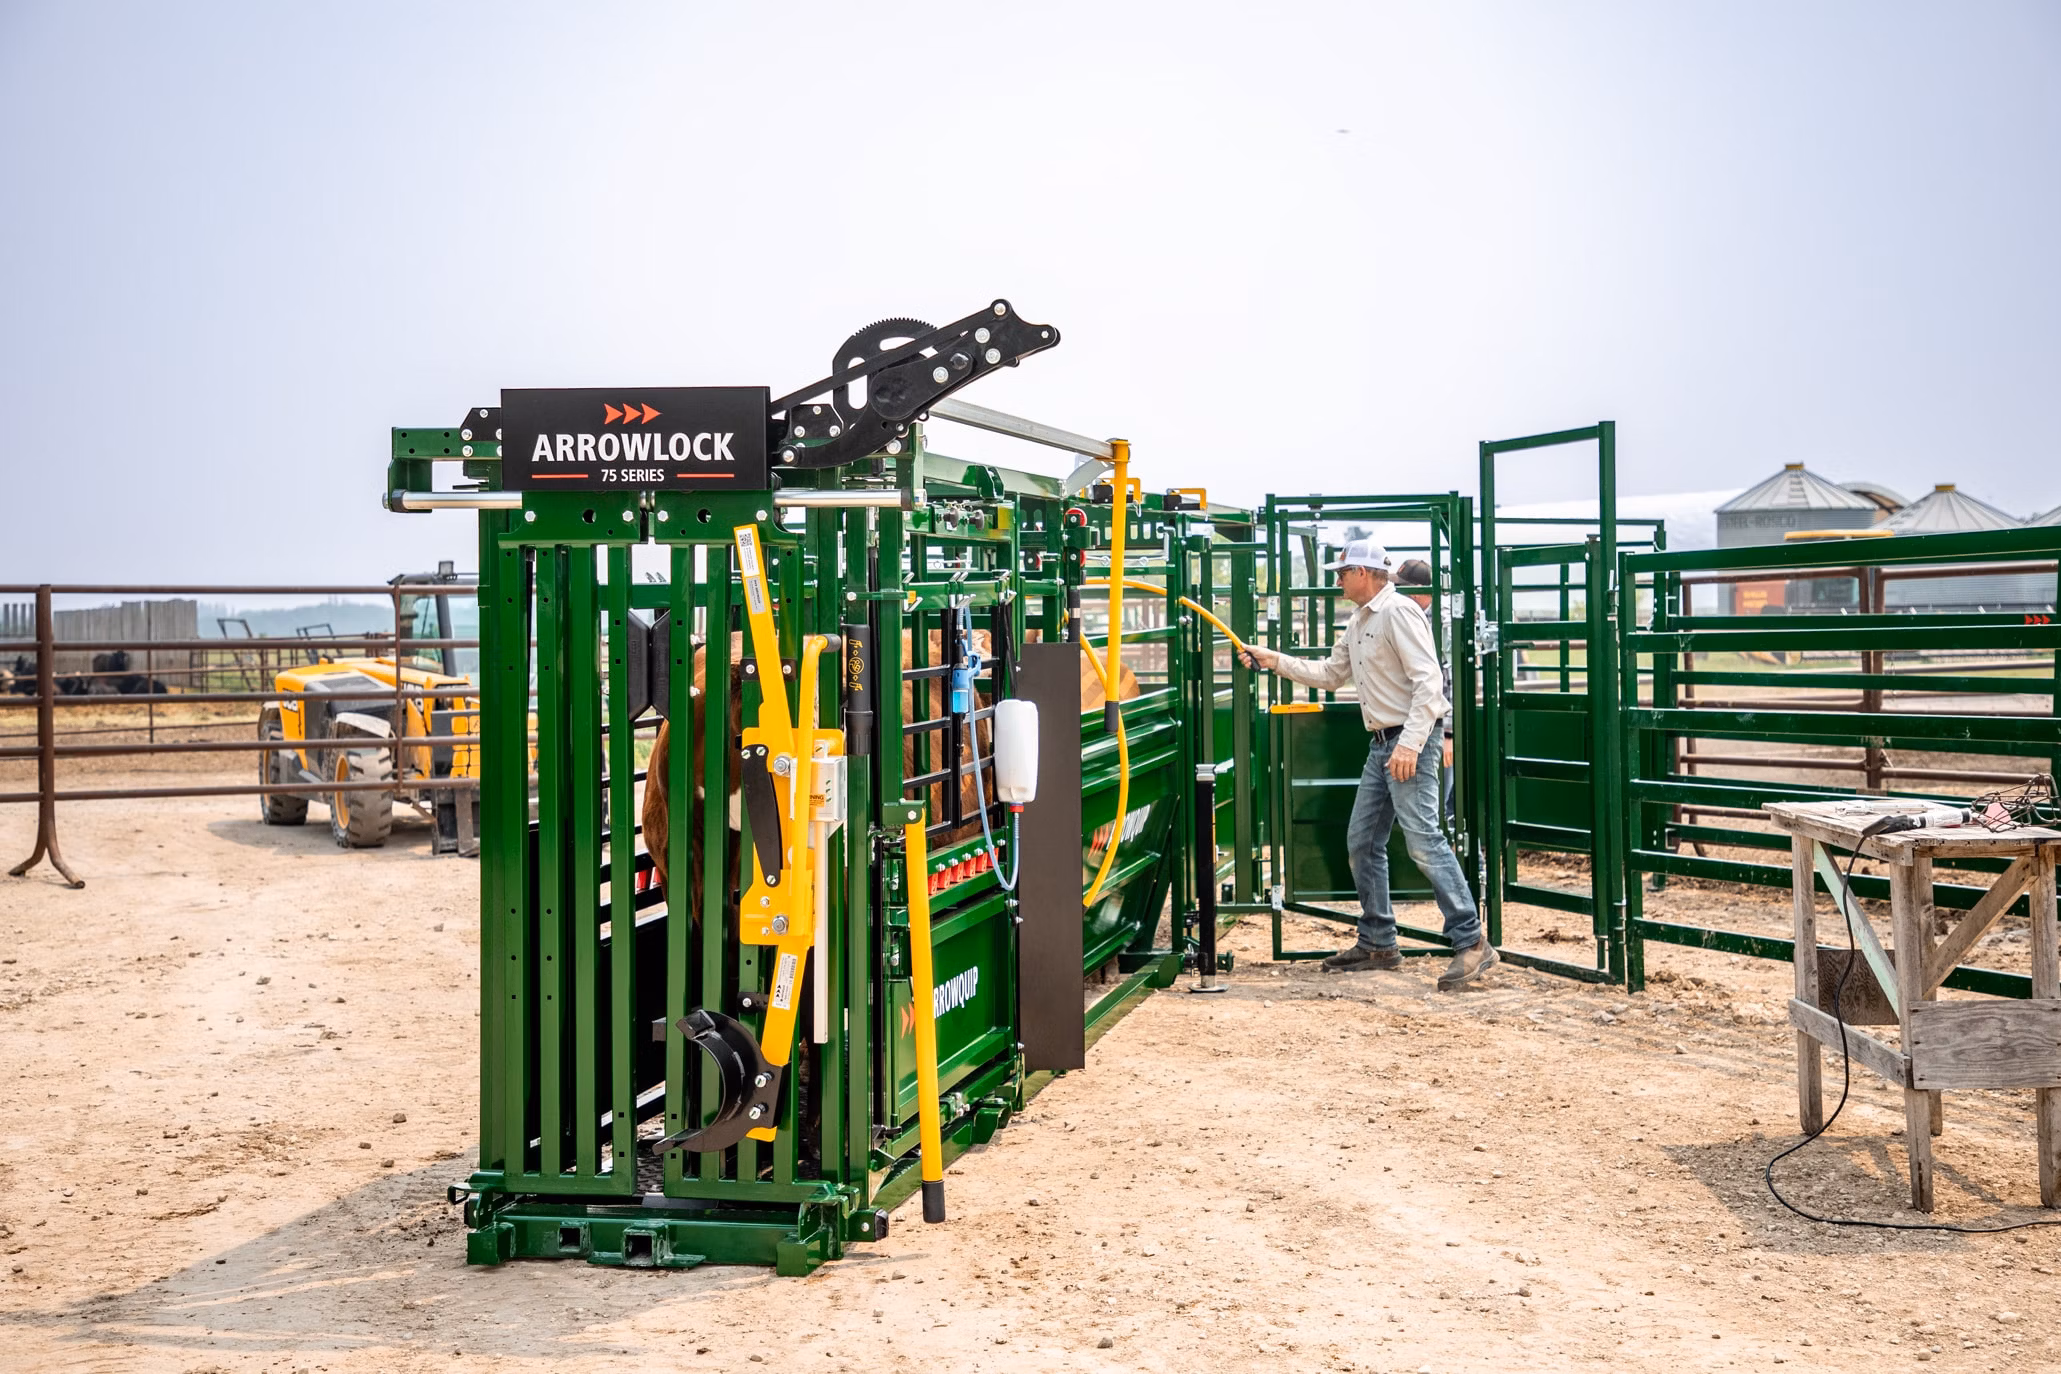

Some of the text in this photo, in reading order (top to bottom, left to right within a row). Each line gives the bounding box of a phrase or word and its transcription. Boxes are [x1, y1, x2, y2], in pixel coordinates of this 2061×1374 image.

[531, 432, 735, 462] ARROWLOCK
[601, 468, 665, 482] 75 SERIES
[933, 965, 979, 1019] RROWQUIP
